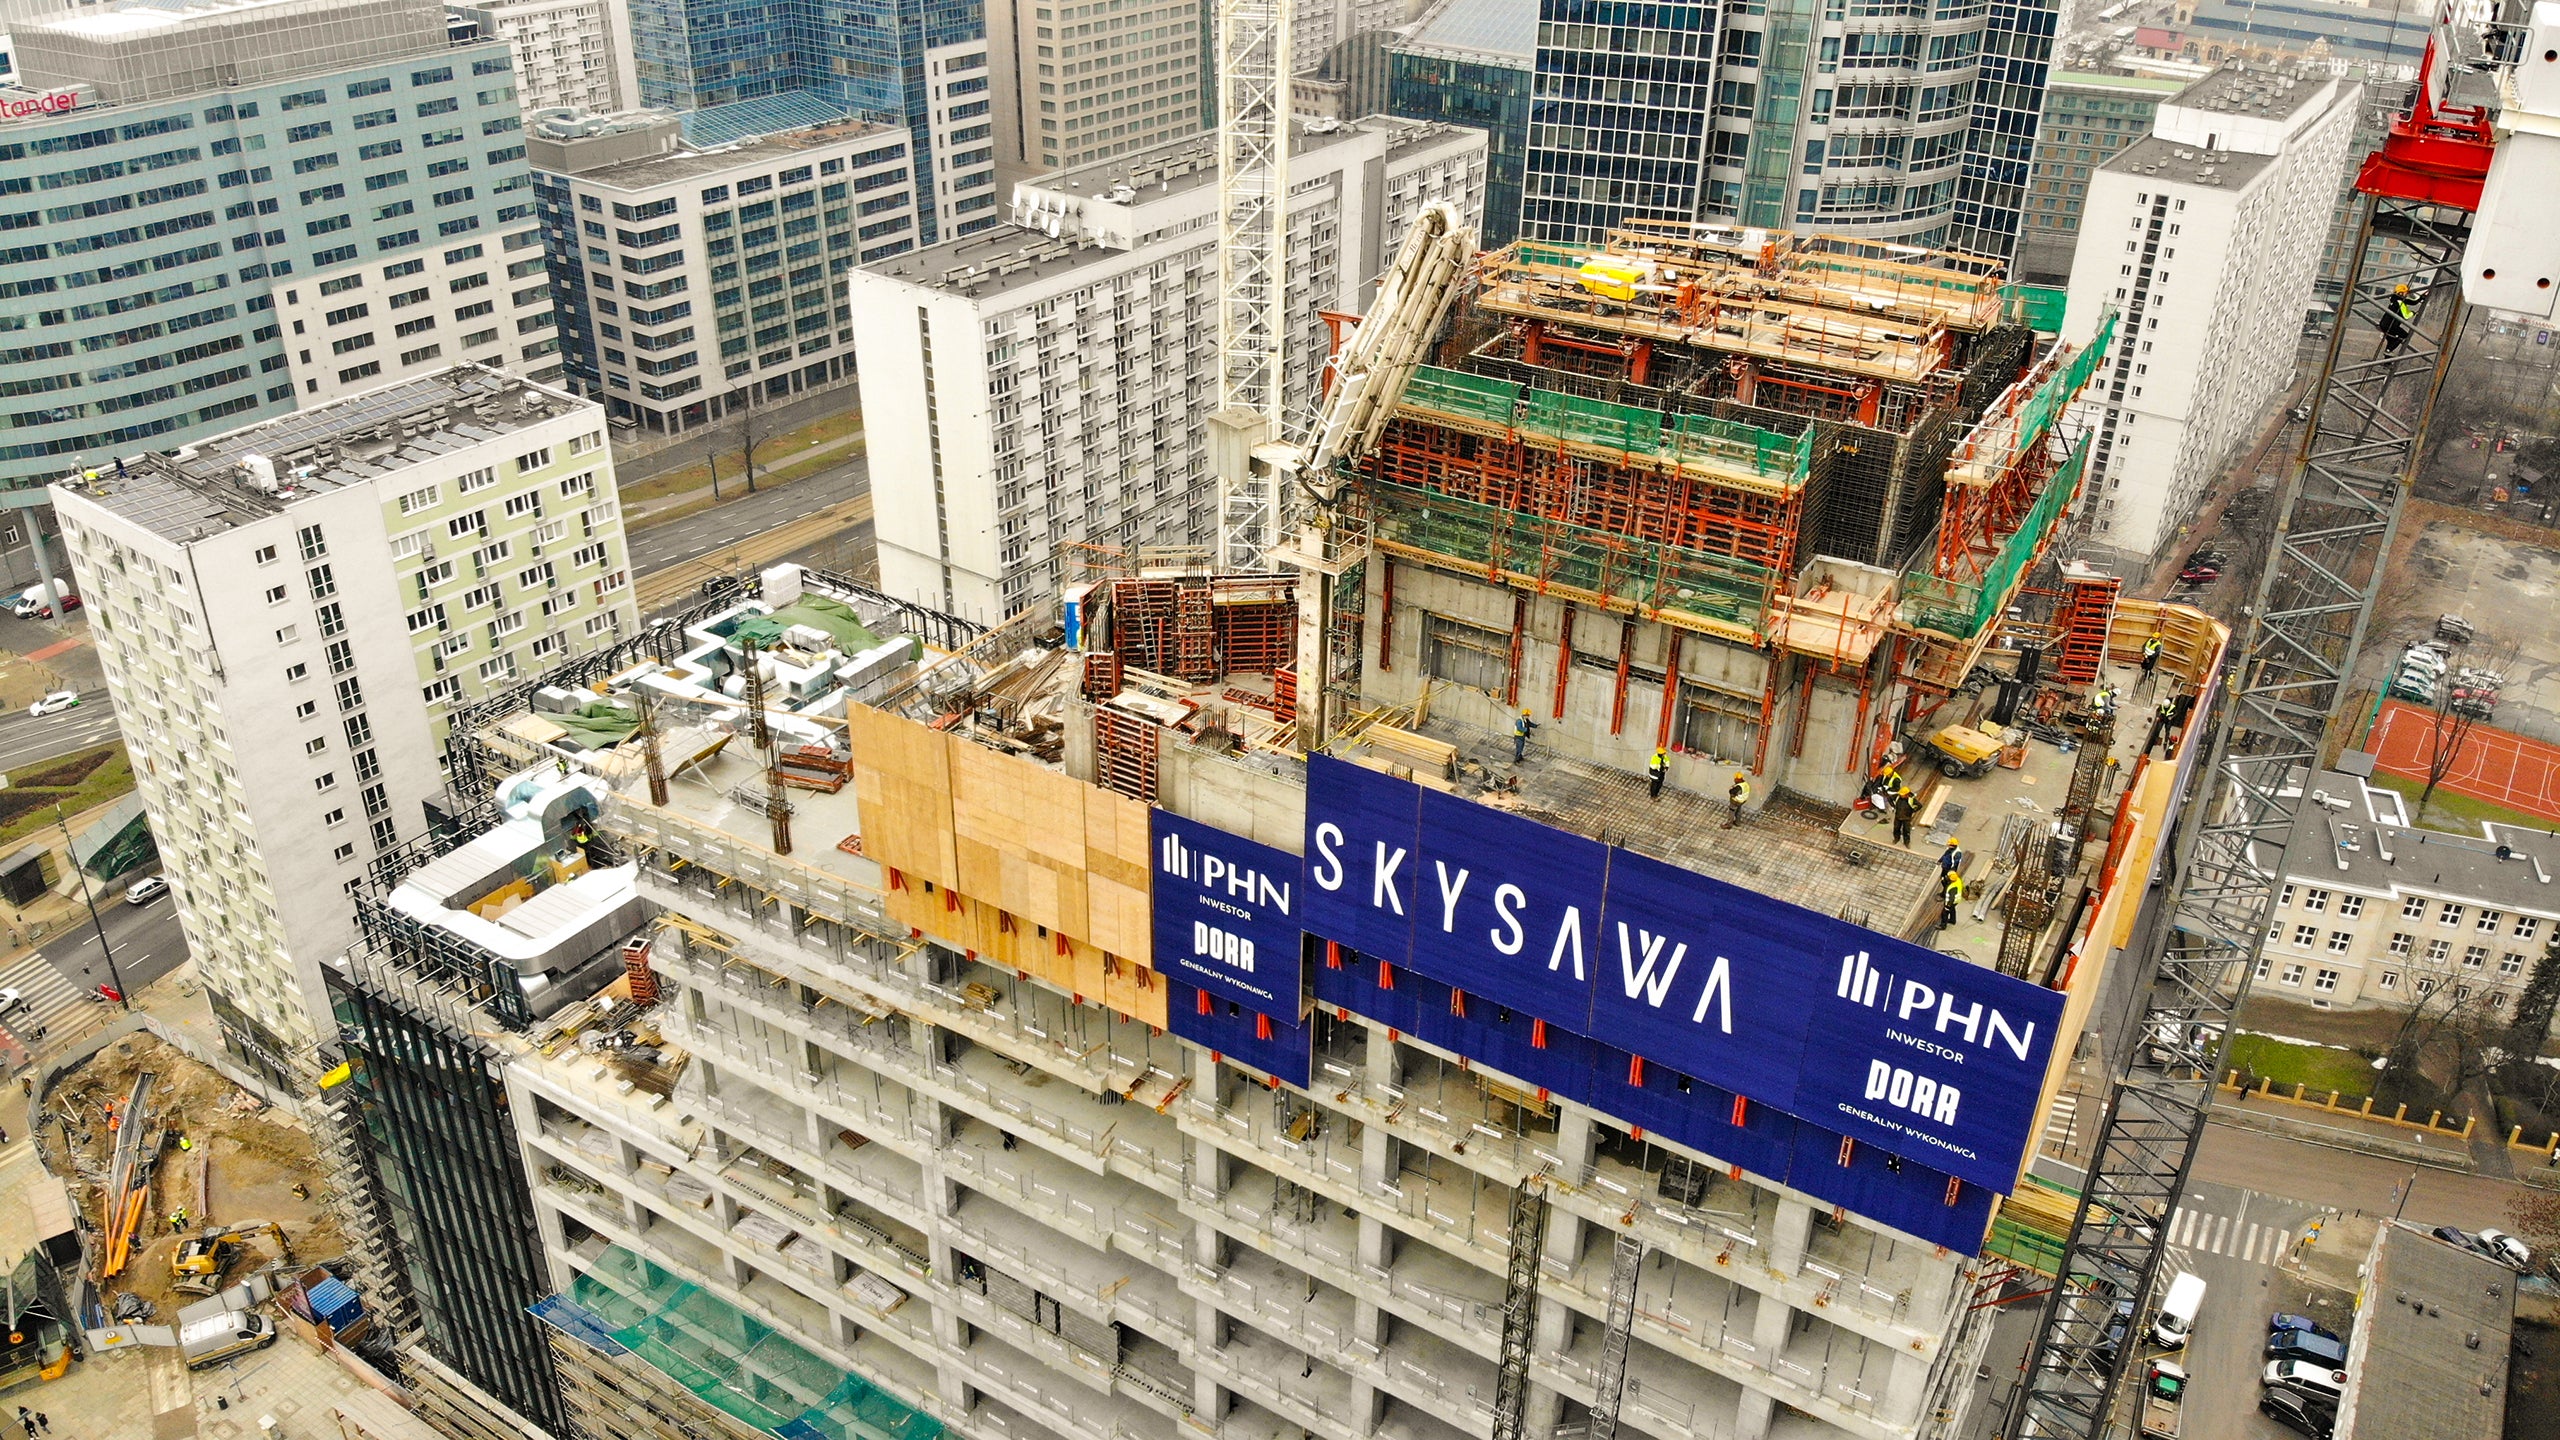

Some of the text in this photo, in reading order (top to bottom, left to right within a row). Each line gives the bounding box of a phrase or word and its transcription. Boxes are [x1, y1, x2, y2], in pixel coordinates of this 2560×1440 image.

[1199, 894, 1252, 921] INWESTOR
[1204, 854, 1290, 916] PHN
[1194, 920, 1255, 973] PORR
[1313, 822, 1732, 1034] SKYSAWA
[1179, 957, 1274, 1001] GENERALNY WYKONAWCA
[1885, 1027, 1965, 1065] INWESTOR
[1898, 979, 2036, 1062] PHN
[1864, 1058, 1961, 1127] PORR
[1838, 1102, 1977, 1161] GENERALNY WYKONAWCA
